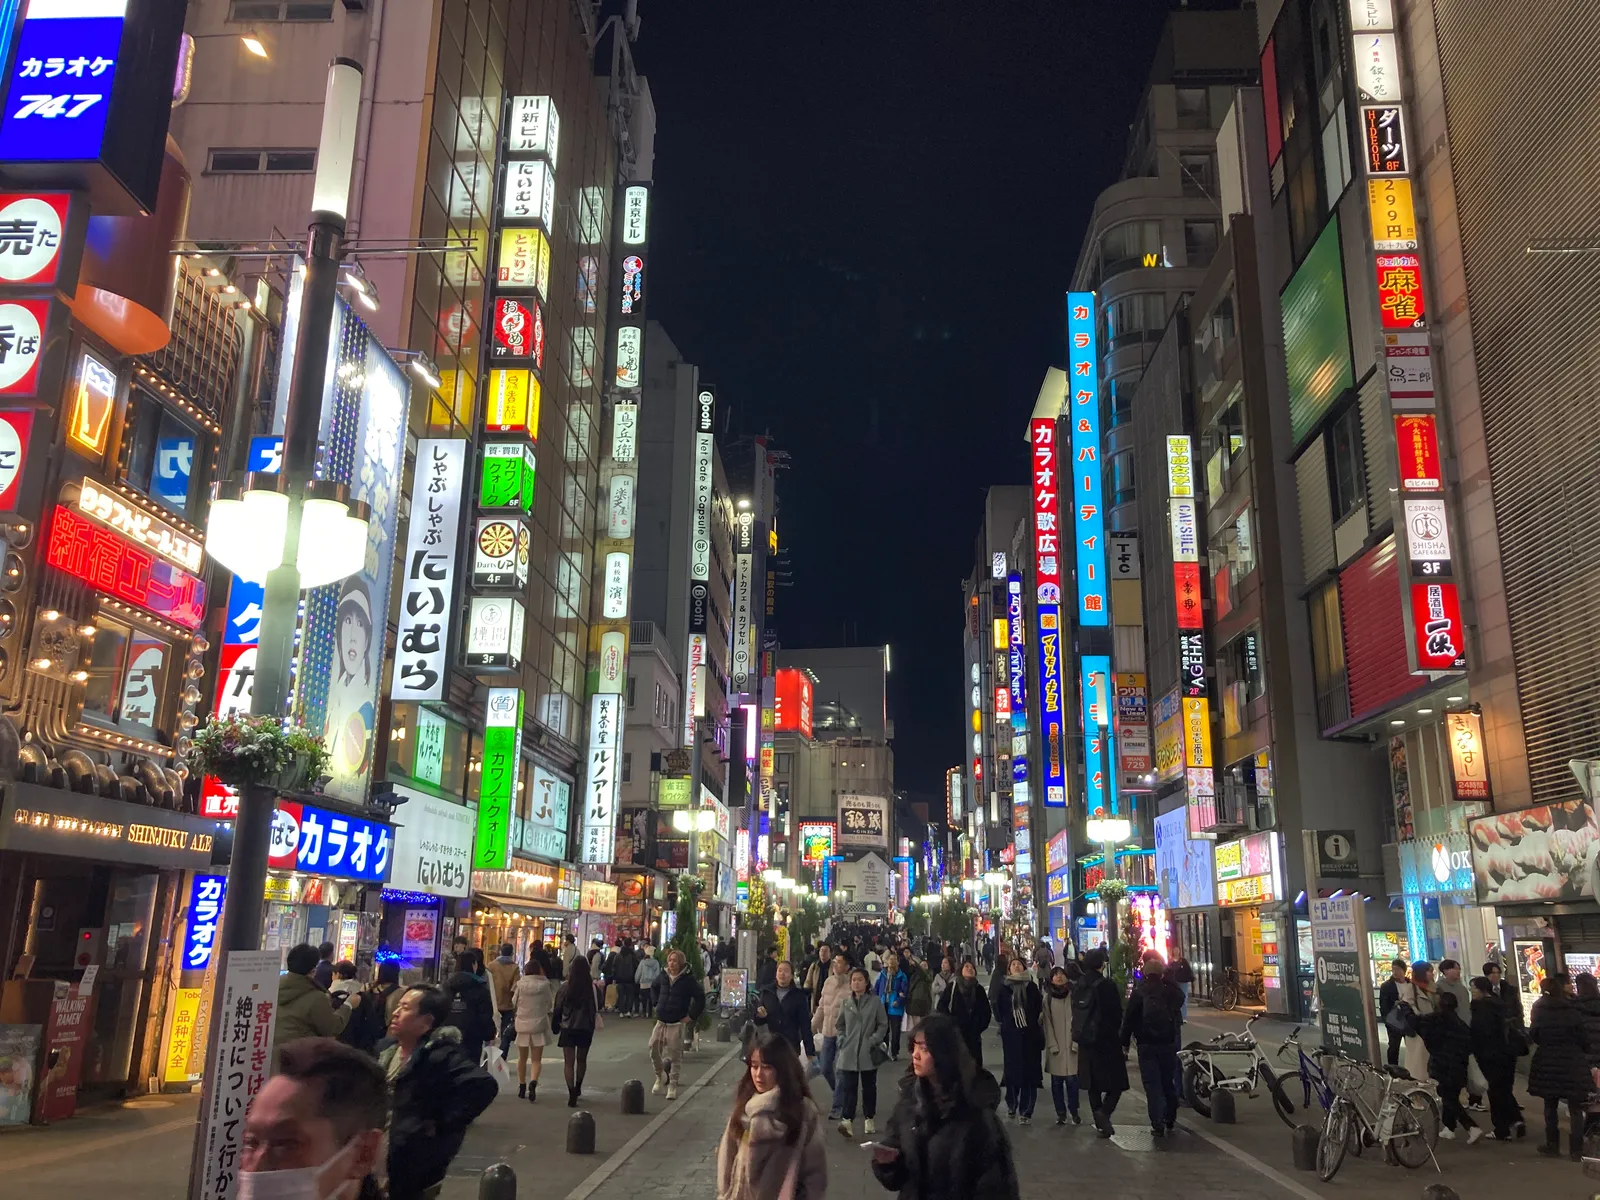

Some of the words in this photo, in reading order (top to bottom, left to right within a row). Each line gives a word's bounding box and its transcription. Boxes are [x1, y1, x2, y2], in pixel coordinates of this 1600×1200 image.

[19, 57, 114, 78] カラオケ
[14, 94, 102, 118] 747
[519, 98, 540, 150] 川新ビル
[1379, 109, 1401, 159] ダーツ
[1368, 110, 1380, 171] HIDEOUT
[1387, 161, 1400, 170] 8F
[514, 163, 533, 214] にいむら
[628, 197, 641, 239] 東京ビル
[37, 232, 58, 248] た
[1377, 257, 1419, 267] ウェルカム
[1381, 268, 1419, 320] 麻雀
[1414, 319, 1426, 328] 6F
[497, 347, 507, 355] 7F
[699, 391, 713, 429] Booth
[700, 438, 709, 455] Net
[1073, 305, 1103, 611] カラオケ&パーティー館
[699, 458, 708, 480] Cafe
[422, 444, 449, 547] しゃぶしゃぶ
[699, 485, 708, 493] &
[1034, 424, 1058, 576] カラオケ歌広場
[697, 496, 708, 536] Capsule
[739, 513, 752, 547] Booth
[1412, 542, 1446, 550] SHISHA
[52, 511, 204, 629] 新宿エール
[477, 561, 497, 572] Darts
[497, 559, 515, 573] UP
[487, 574, 501, 584] 4F
[1422, 562, 1441, 574] 3F
[691, 586, 706, 625] Booth
[1428, 588, 1443, 618] 居酒屋
[400, 550, 449, 691] にいむら
[1427, 620, 1453, 656] 一休
[482, 654, 494, 664] 3F
[1042, 634, 1058, 712] マツモトキヨシ
[1189, 634, 1204, 688] AGEHA
[1189, 687, 1200, 695] 2F
[597, 699, 610, 744] 喫茶室
[1050, 723, 1059, 743] Shop
[762, 749, 772, 768] 麻雀
[1050, 744, 1060, 762] Free
[1127, 761, 1146, 769] 729
[590, 750, 611, 820] ルノアール
[1050, 762, 1060, 779] Tax
[128, 823, 189, 850] SHINJUKU
[190, 834, 213, 852] ALE
[298, 813, 389, 875] カラオケ
[417, 856, 465, 889] にいむら
[188, 878, 223, 967] カラオケ
[55, 999, 86, 1014] WALKING
[56, 1011, 82, 1027] RAMEN
[174, 1010, 191, 1068] 品种齐全
[214, 996, 253, 1200] 絶対について行か
